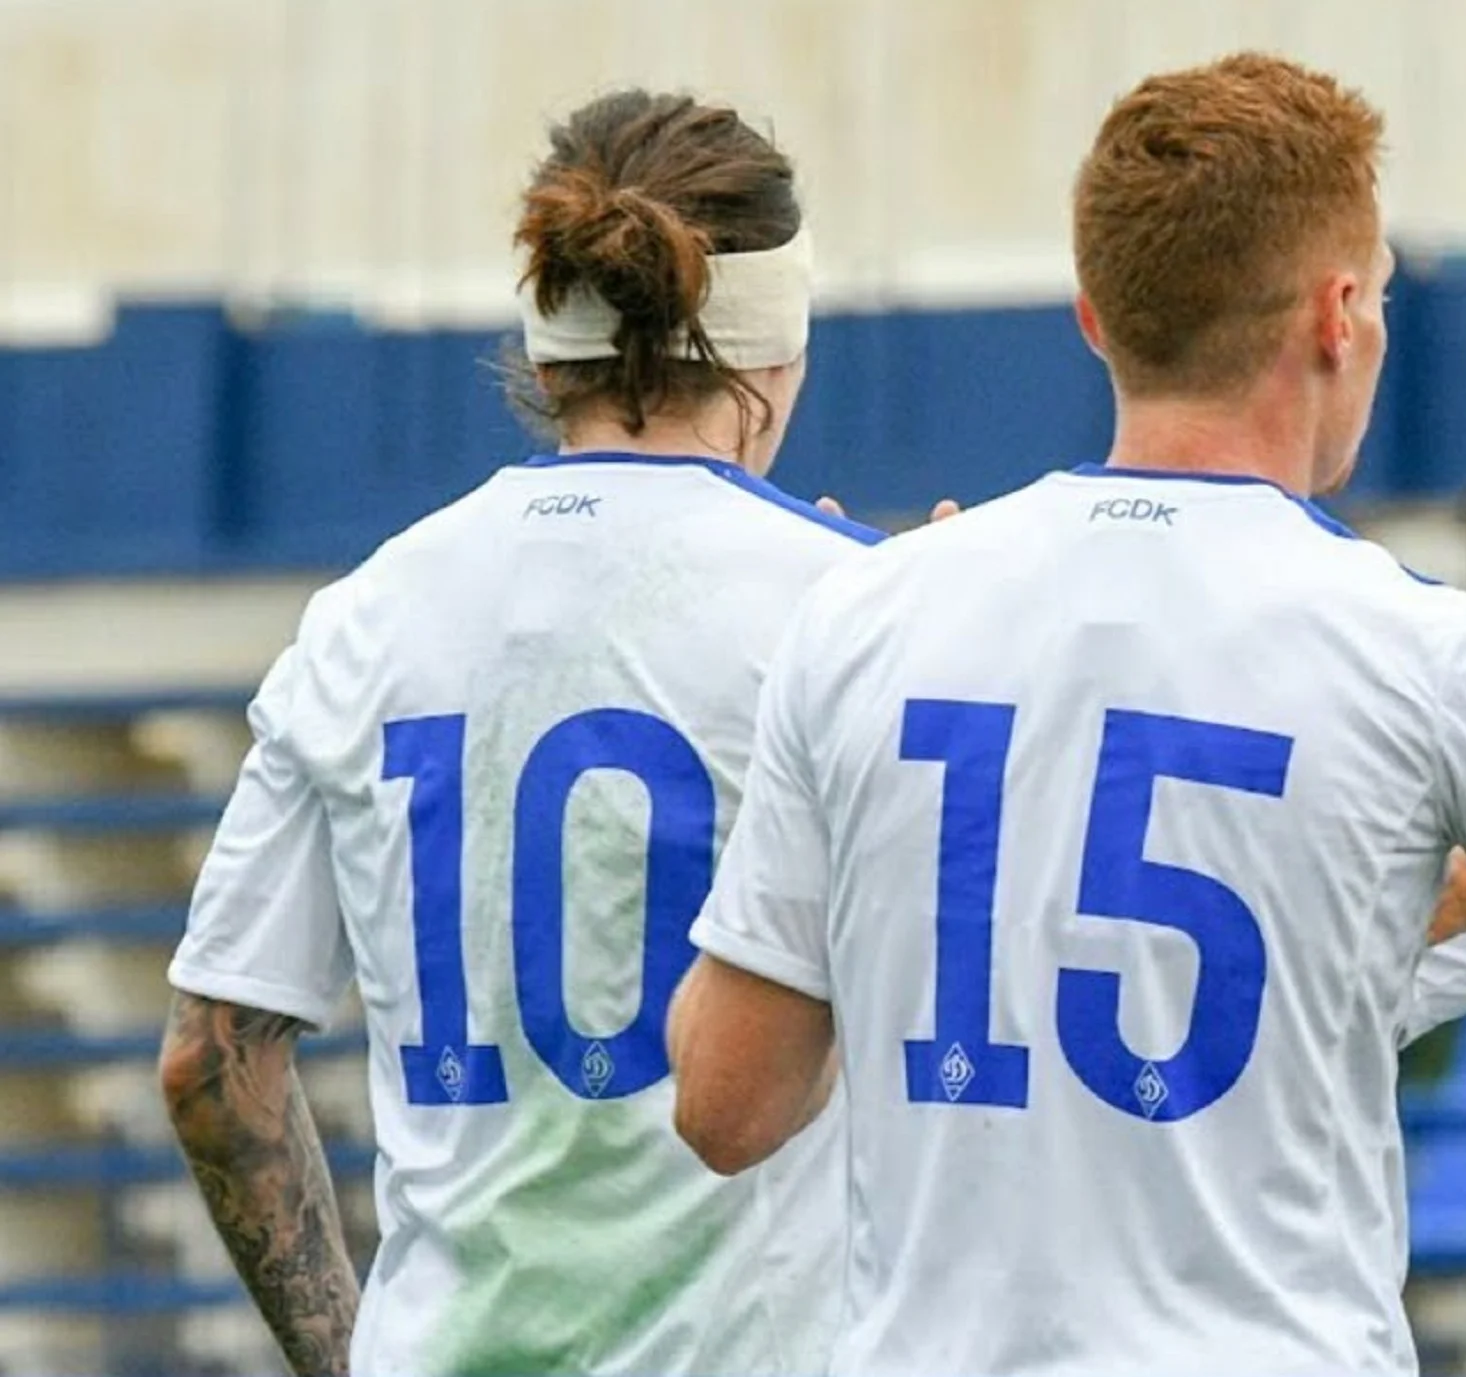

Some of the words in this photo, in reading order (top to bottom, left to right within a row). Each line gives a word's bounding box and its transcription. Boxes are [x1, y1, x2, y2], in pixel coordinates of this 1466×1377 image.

[1088, 498, 1178, 526] FCDK
[381, 708, 715, 1106] 10
[899, 698, 1294, 1123] 15
